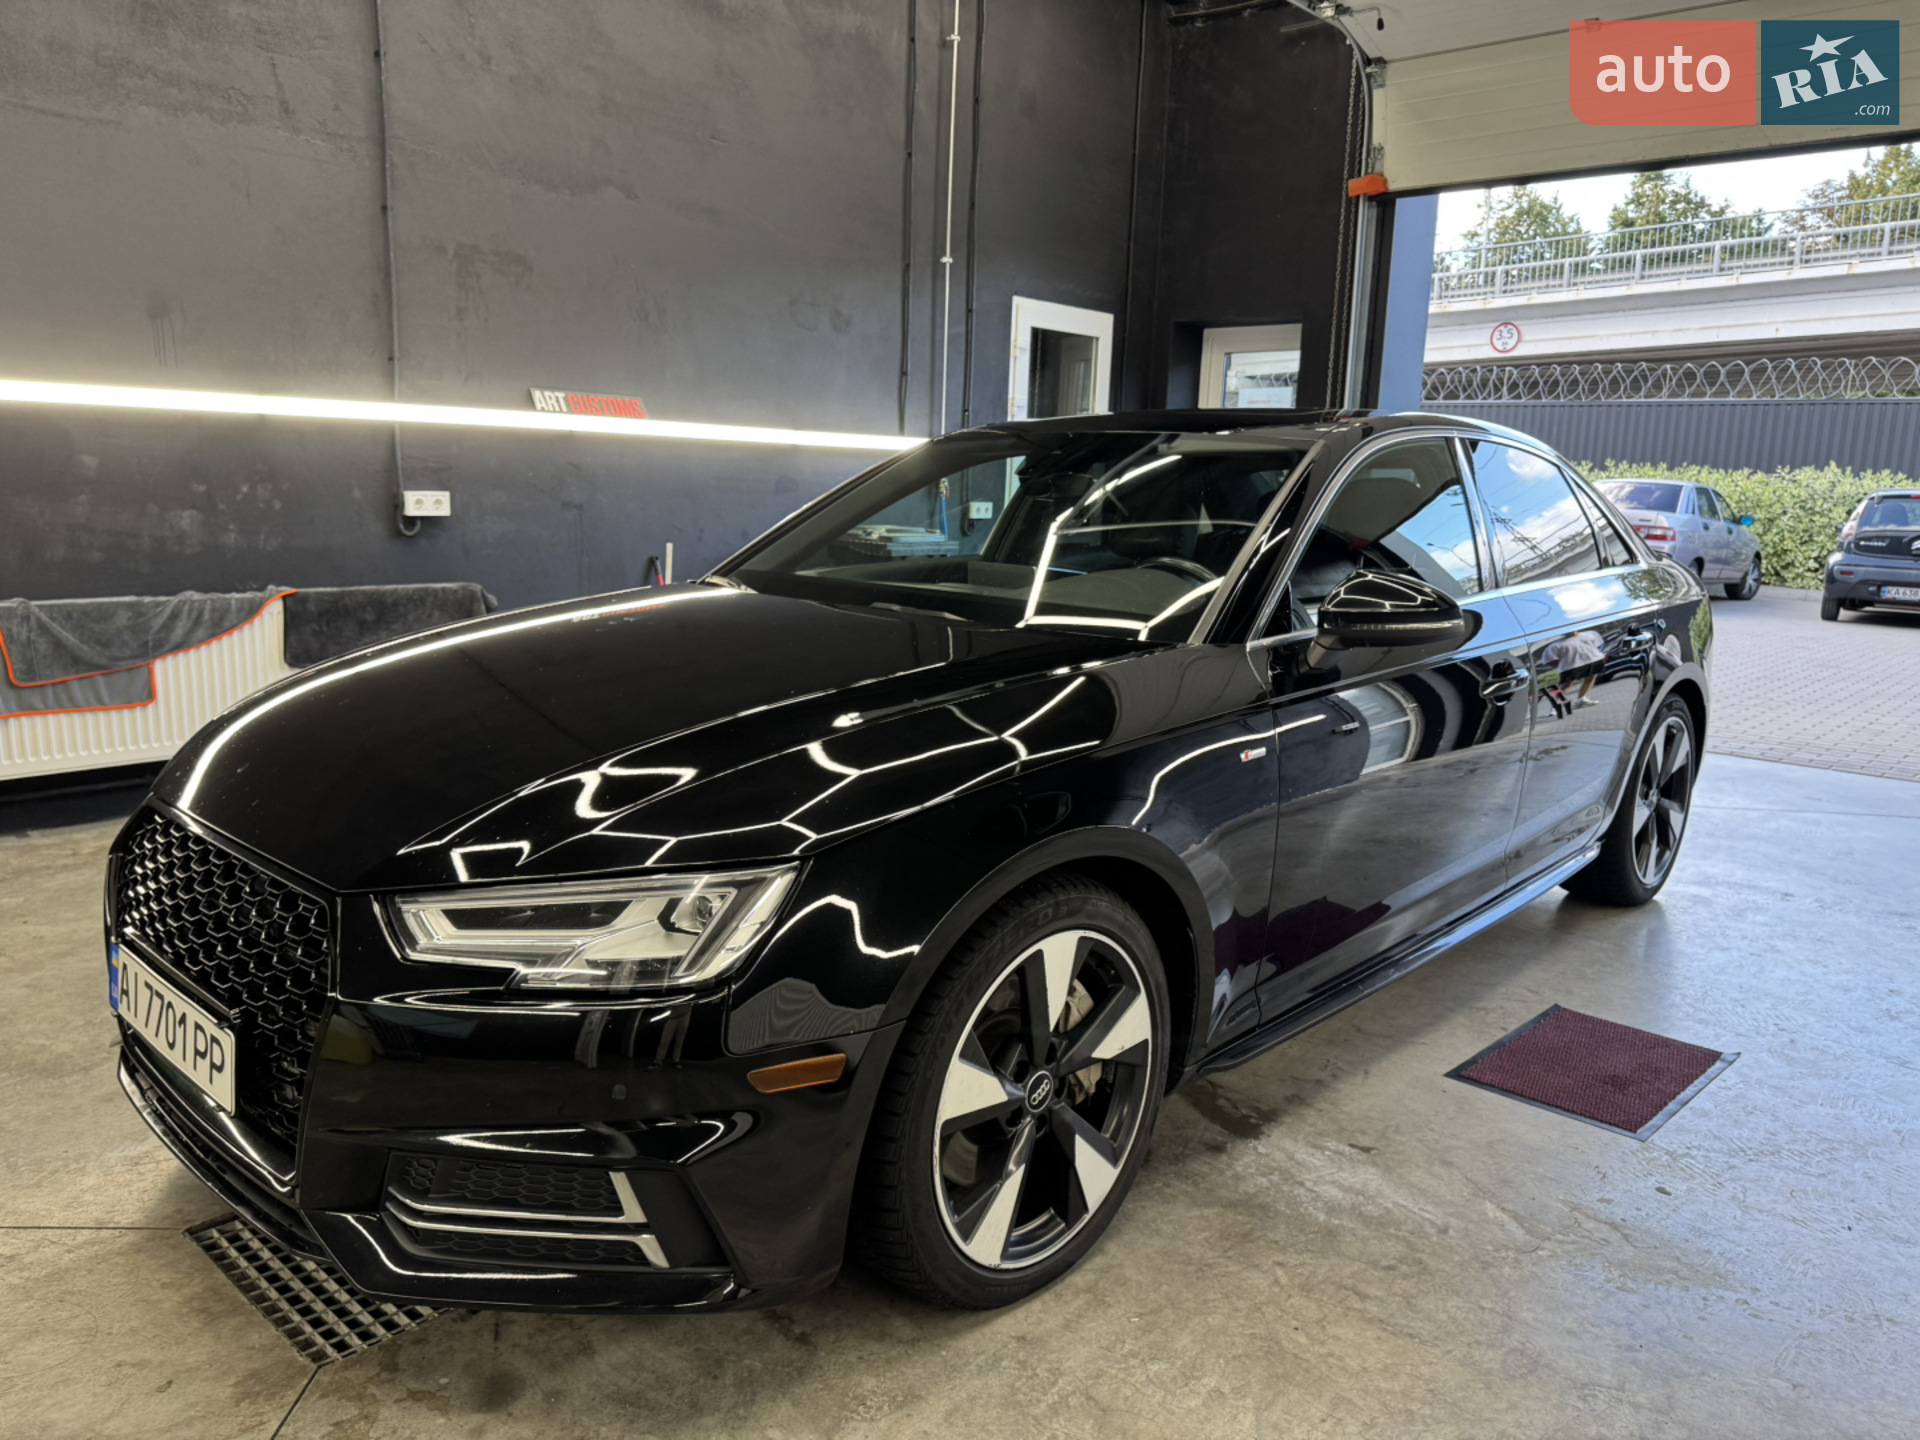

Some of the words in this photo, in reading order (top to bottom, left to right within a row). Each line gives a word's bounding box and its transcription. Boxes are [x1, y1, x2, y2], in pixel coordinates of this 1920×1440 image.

[533, 389, 568, 413] ART
[567, 394, 646, 419] CUSTOMS
[119, 960, 139, 1020] AI
[143, 979, 188, 1063] 7701
[193, 1019, 226, 1086] PP
